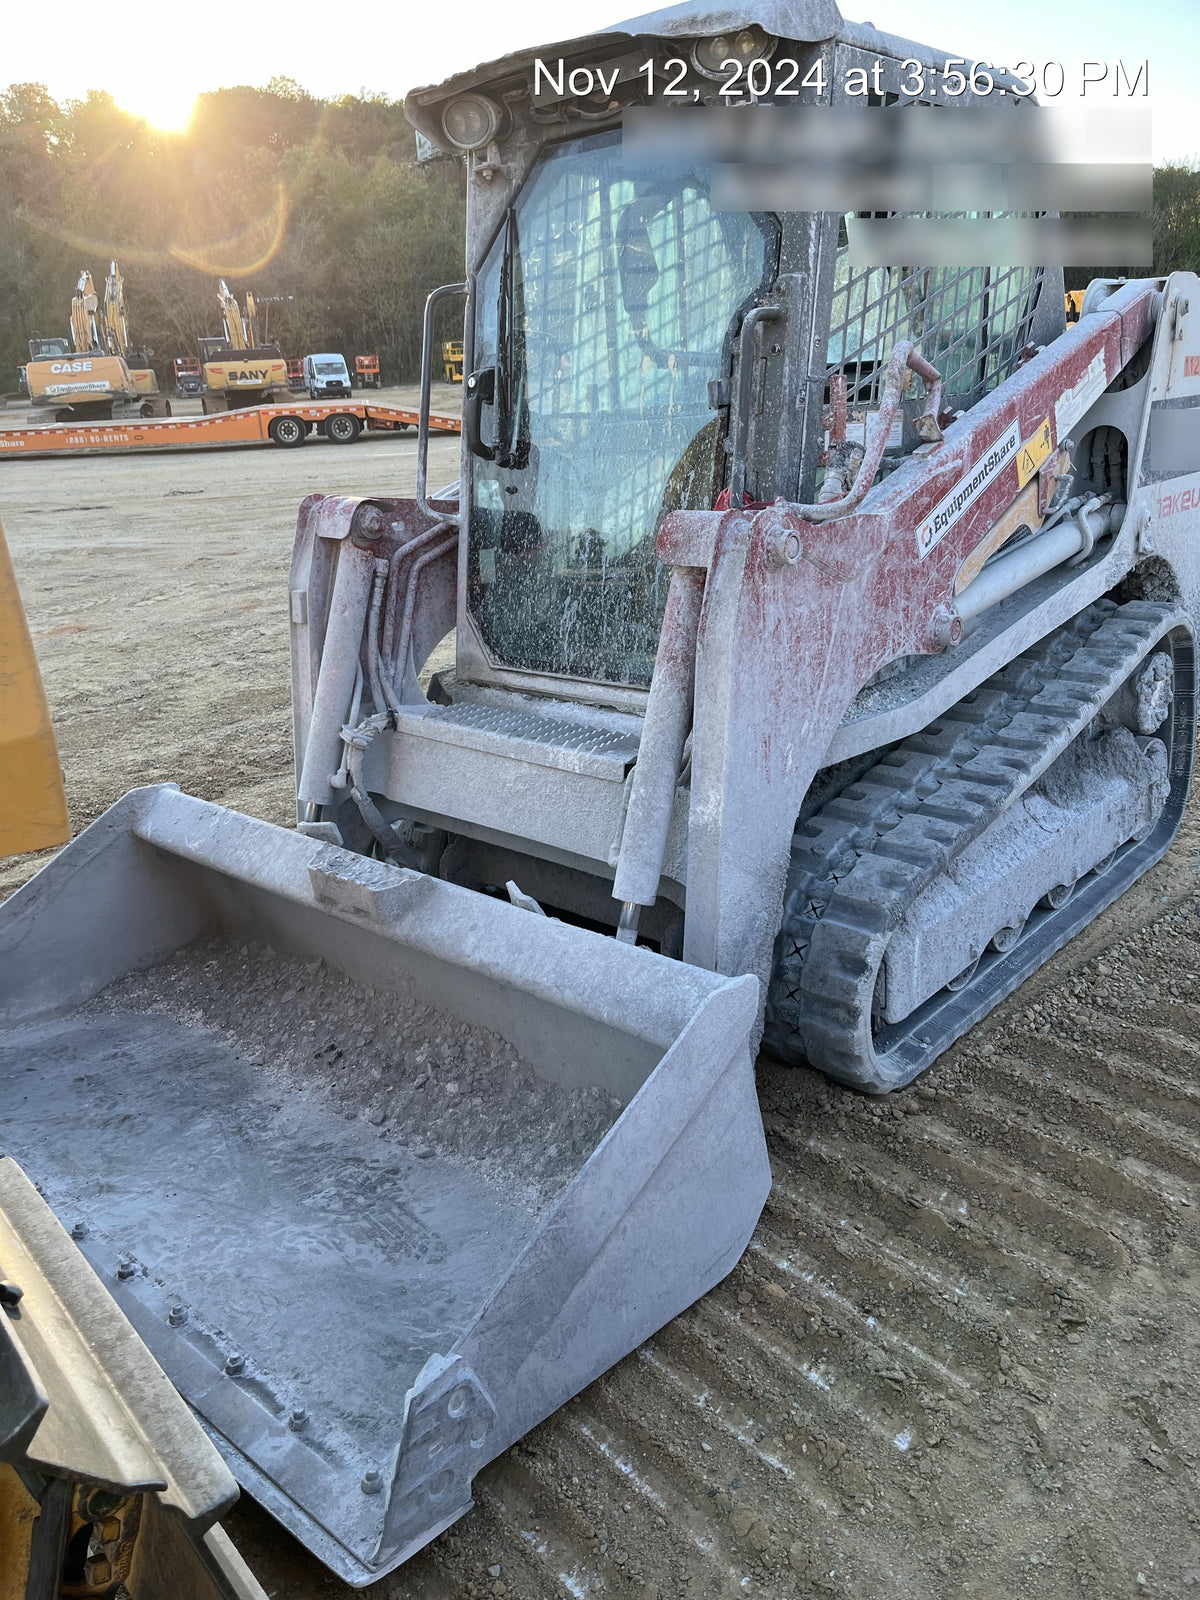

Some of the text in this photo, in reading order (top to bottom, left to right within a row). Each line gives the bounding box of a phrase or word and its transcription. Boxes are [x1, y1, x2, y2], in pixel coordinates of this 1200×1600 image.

[51, 361, 93, 374] CASE
[228, 370, 269, 381] SANY
[933, 434, 1017, 534] EquipmentShare
